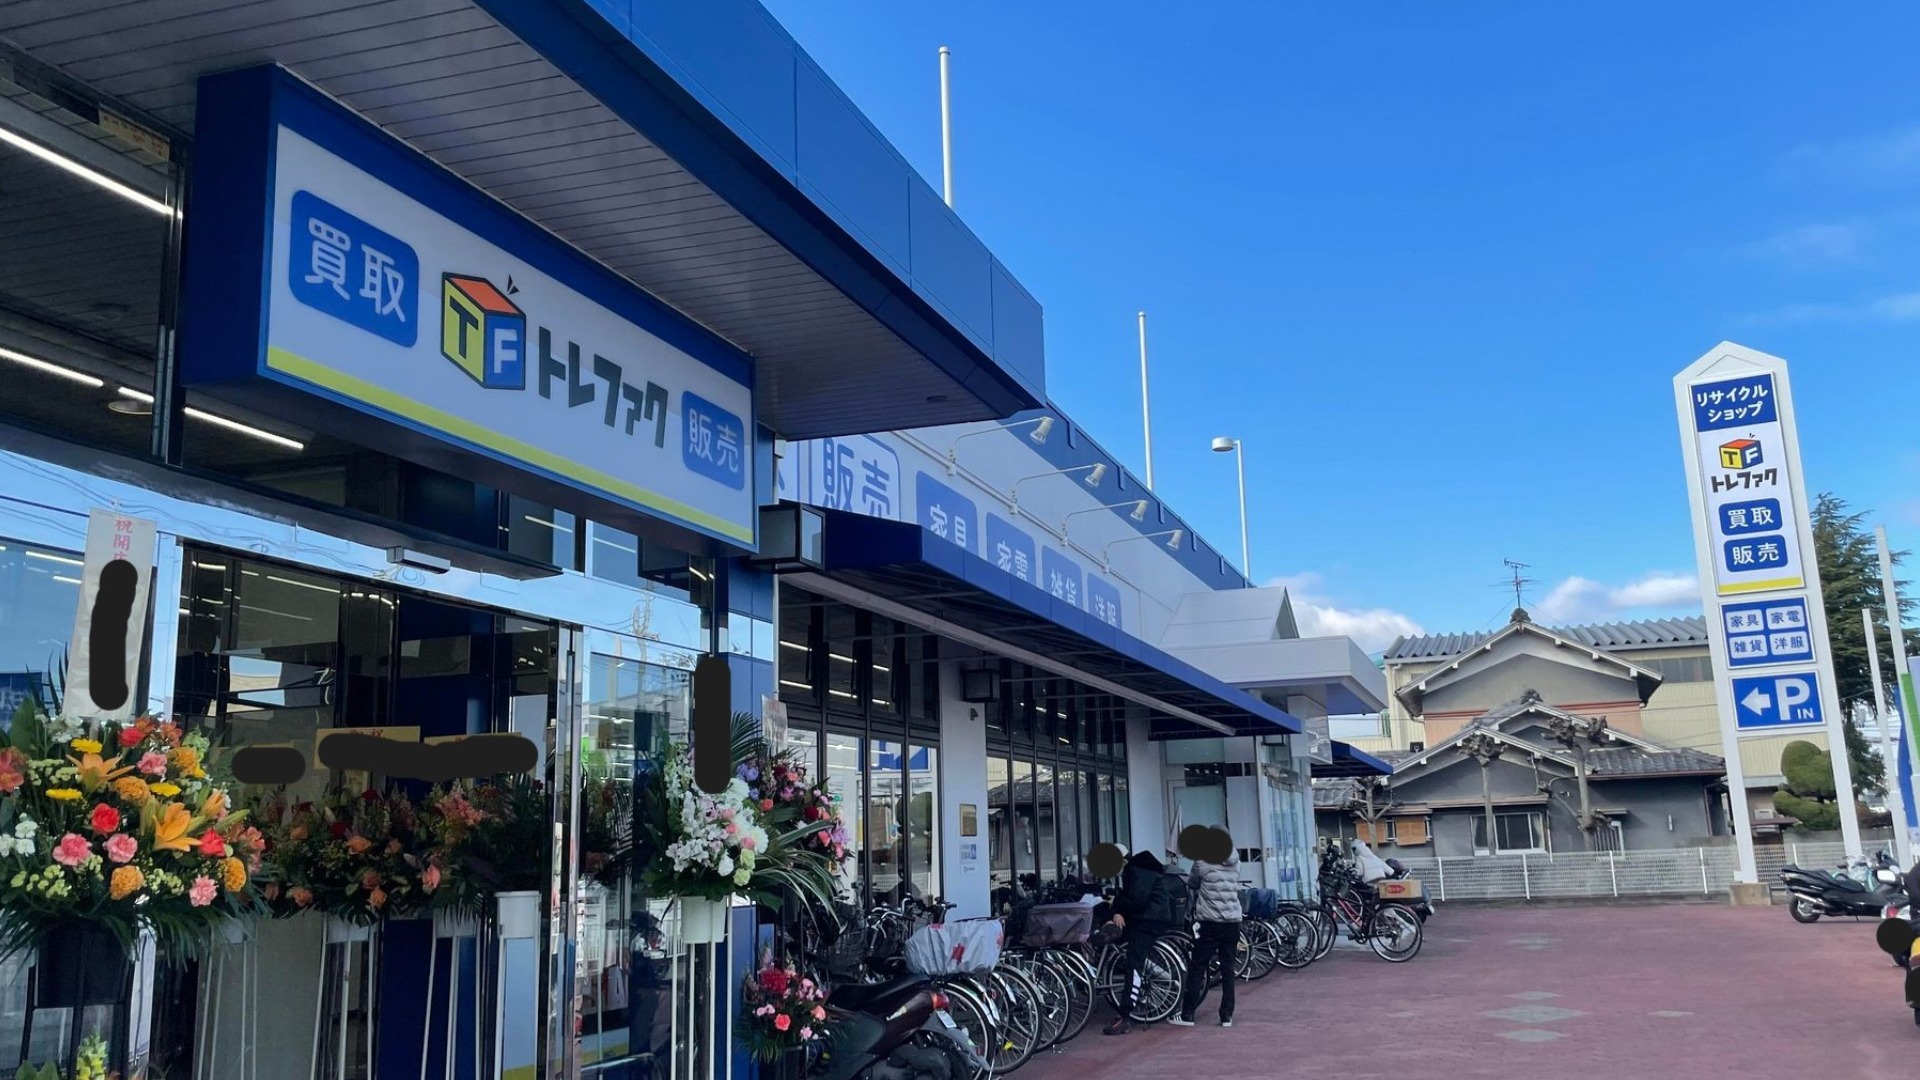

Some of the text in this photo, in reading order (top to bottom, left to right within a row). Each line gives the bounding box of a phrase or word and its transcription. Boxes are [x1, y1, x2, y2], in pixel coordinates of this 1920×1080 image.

[304, 217, 405, 323] 買取
[450, 298, 518, 374] TF
[538, 325, 669, 449] トレファク
[1696, 384, 1769, 407] リサイクル
[1708, 401, 1763, 423] ショップ
[687, 408, 740, 474] 販売
[1722, 447, 1759, 466] TF
[822, 437, 890, 517] 販売
[1711, 468, 1778, 493] トレファク
[1727, 506, 1774, 528] 買取
[1732, 543, 1779, 565] 販売
[1730, 614, 1760, 629] 家具
[1770, 610, 1801, 624] 家電
[1733, 637, 1765, 654] 雑貨
[1774, 633, 1804, 649] 洋服
[1775, 678, 1815, 720] P IN
